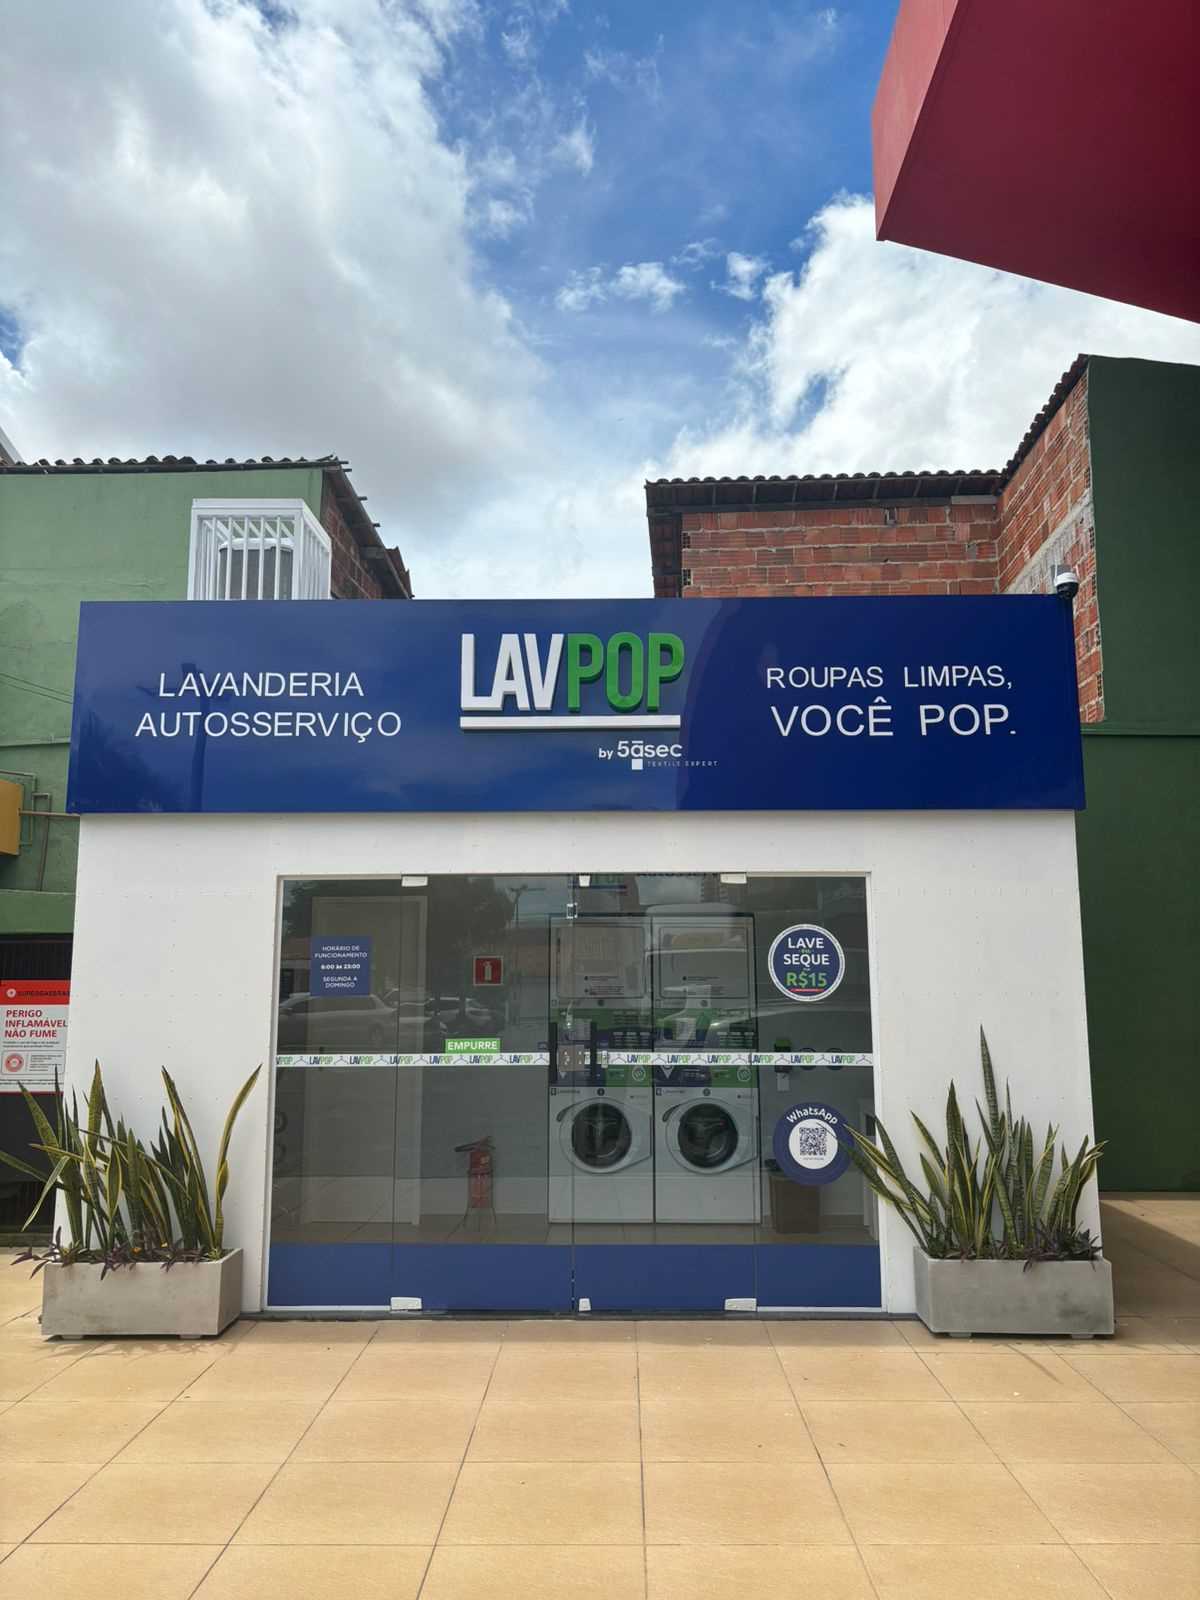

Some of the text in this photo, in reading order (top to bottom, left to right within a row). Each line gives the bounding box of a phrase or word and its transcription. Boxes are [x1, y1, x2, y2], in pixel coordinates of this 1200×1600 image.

[460, 631, 685, 713] LAVPOP
[765, 664, 1014, 691] ROUPAS LIMPAS,
[158, 672, 364, 697] LAVANDERIA
[770, 697, 1016, 738] VOCÊ POP.
[135, 711, 401, 743] AUTOSSERVIÇO
[598, 748, 614, 760] by
[787, 937, 825, 949] LAVE
[783, 953, 831, 967] SEQUE
[786, 971, 828, 988] R$15
[6, 1009, 42, 1018] PERIGO
[5, 1018, 68, 1028] INFLAMÁVEL
[4, 1028, 58, 1038] NÃO FUME
[447, 1040, 498, 1051] EMPURRE
[309, 1056, 333, 1065] LAVPOP
[350, 1056, 374, 1065] LAVPOP
[390, 1055, 414, 1064] LAVPOP
[429, 1055, 453, 1064] LAVPOP
[469, 1055, 493, 1064] LAVPOP
[509, 1055, 534, 1064] LAVPOP
[627, 1054, 652, 1063] LAVPOP
[667, 1054, 691, 1063] LAVPOP
[707, 1054, 731, 1063] LAVPOP
[790, 1055, 815, 1064] LAVPOP
[831, 1055, 855, 1064] LAVPOP
[786, 1106, 838, 1125] WhatsApp
